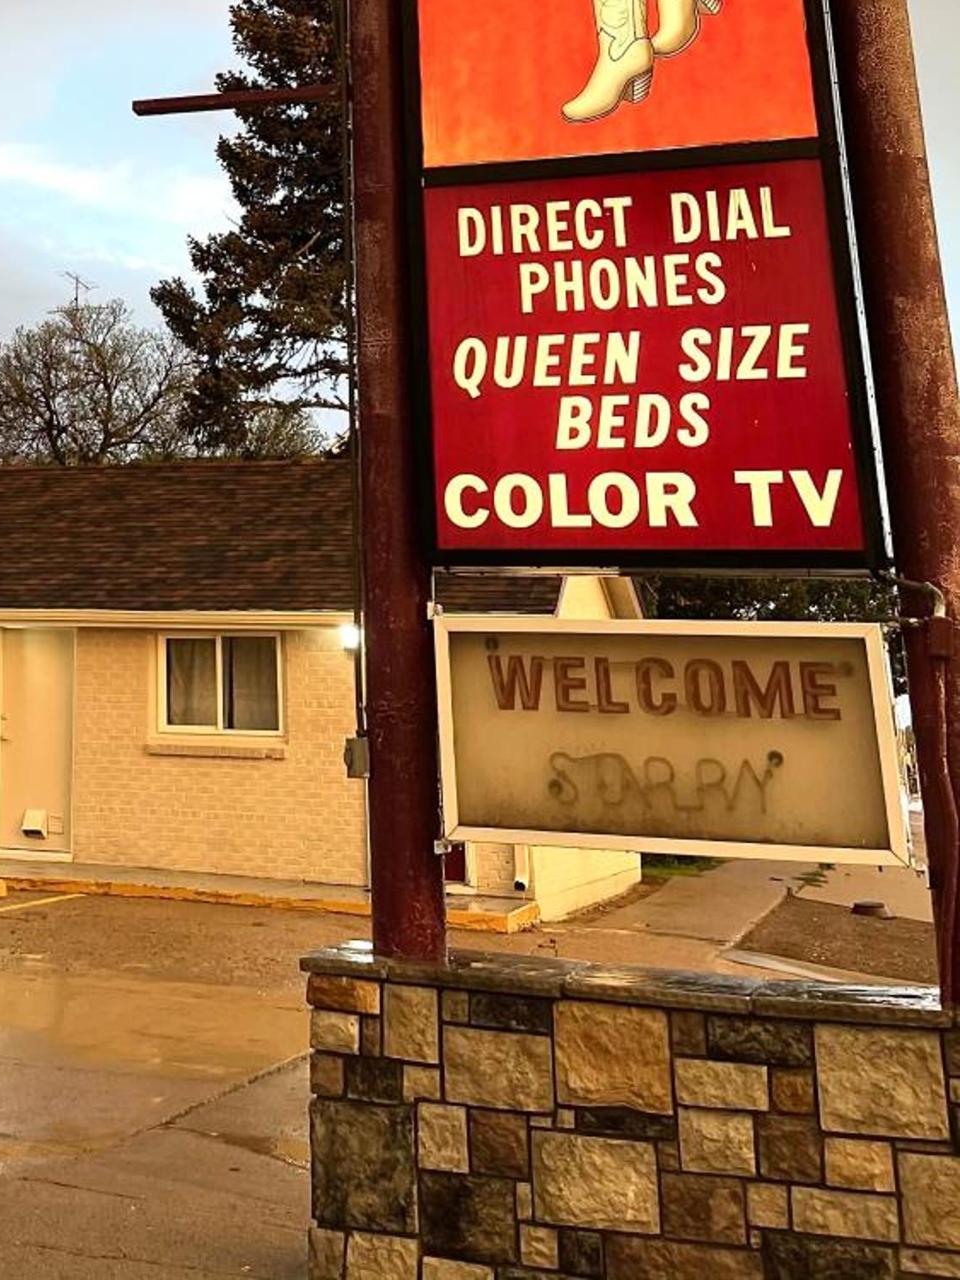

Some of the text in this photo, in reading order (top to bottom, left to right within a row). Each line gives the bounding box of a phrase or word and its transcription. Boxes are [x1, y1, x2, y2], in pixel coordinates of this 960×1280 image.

[457, 186, 791, 257] DIRECT DIAL
[519, 252, 726, 314] PHONES
[452, 323, 810, 399] QUEEN SIZE
[554, 392, 712, 450] BEDS
[444, 469, 843, 529] COLOR TV
[487, 654, 841, 720] WELCOME
[547, 750, 784, 815] SORRY
